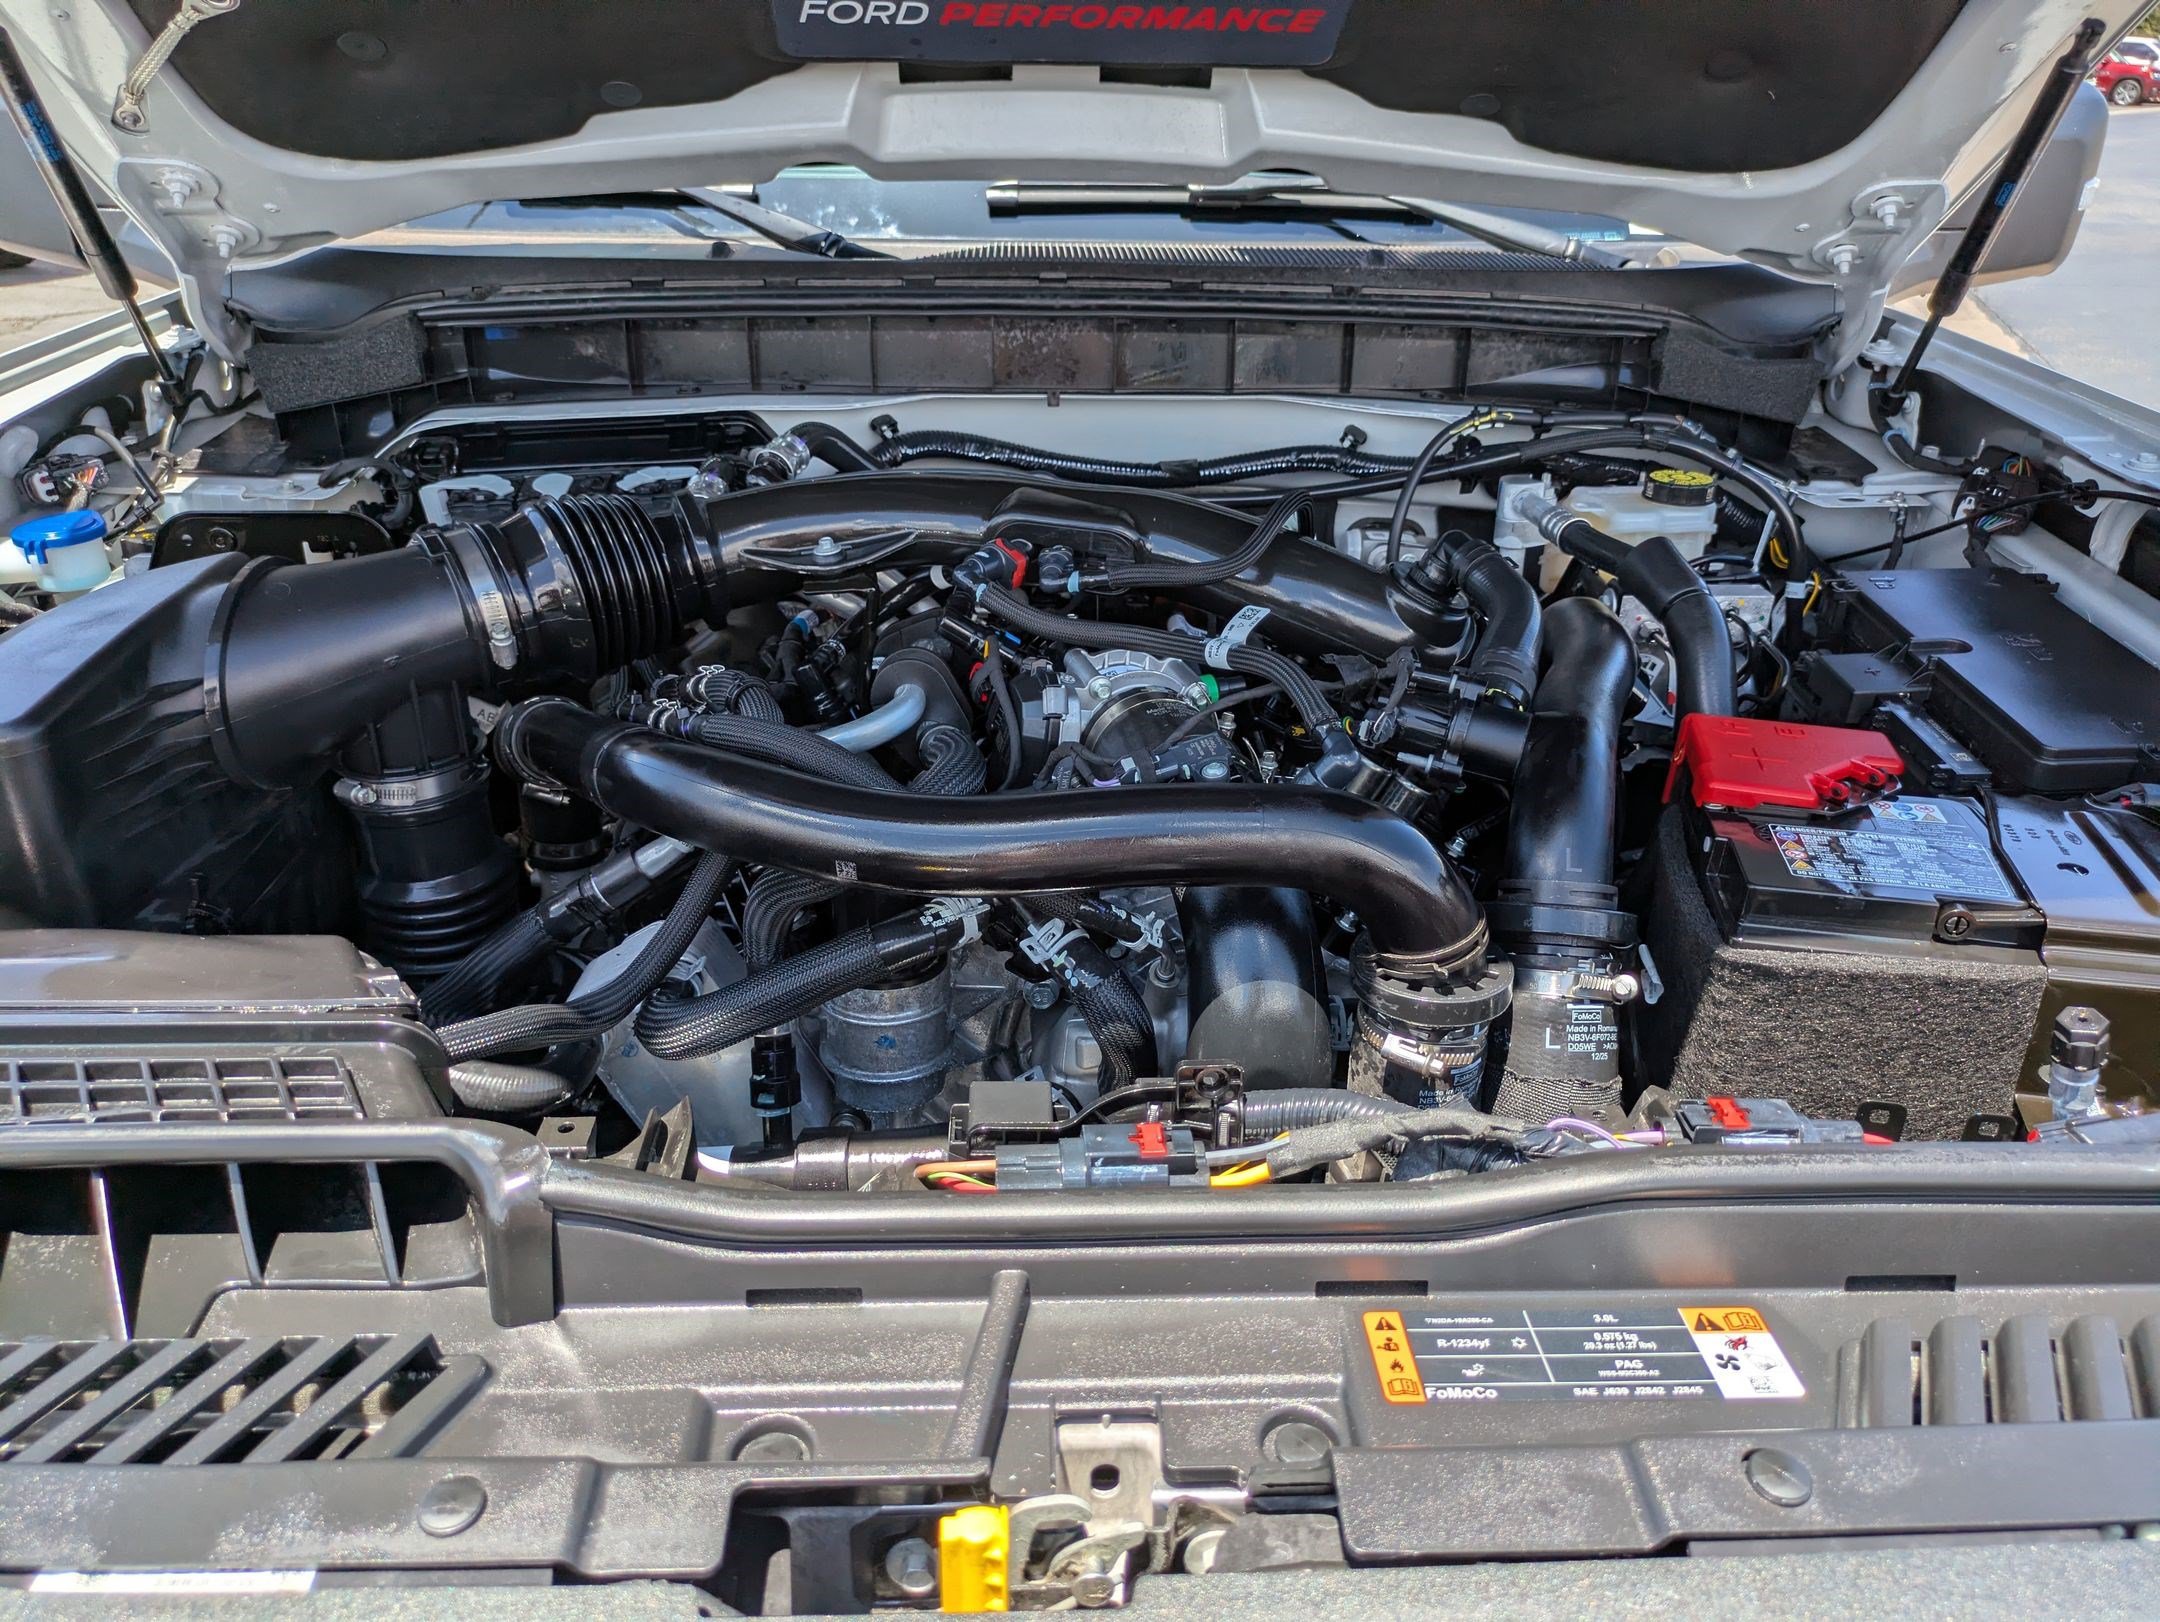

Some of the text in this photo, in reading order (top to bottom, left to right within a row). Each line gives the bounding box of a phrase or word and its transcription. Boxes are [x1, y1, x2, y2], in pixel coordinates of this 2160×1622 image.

[799, 0, 1326, 33] FORD PERFORMANCE
[1566, 847, 1582, 873] L
[1573, 1012, 1600, 1020] FoMoCo
[1545, 1027, 1561, 1048] L
[1591, 1052, 1608, 1061] 12/25
[1418, 1089, 1444, 1097] Made
[1623, 1332, 1639, 1342] kg
[1436, 1338, 1491, 1349] R-1234yf
[1614, 1359, 1644, 1369] PAG
[1425, 1386, 1498, 1400] FoMoCo
[1573, 1387, 1599, 1396] SAE
